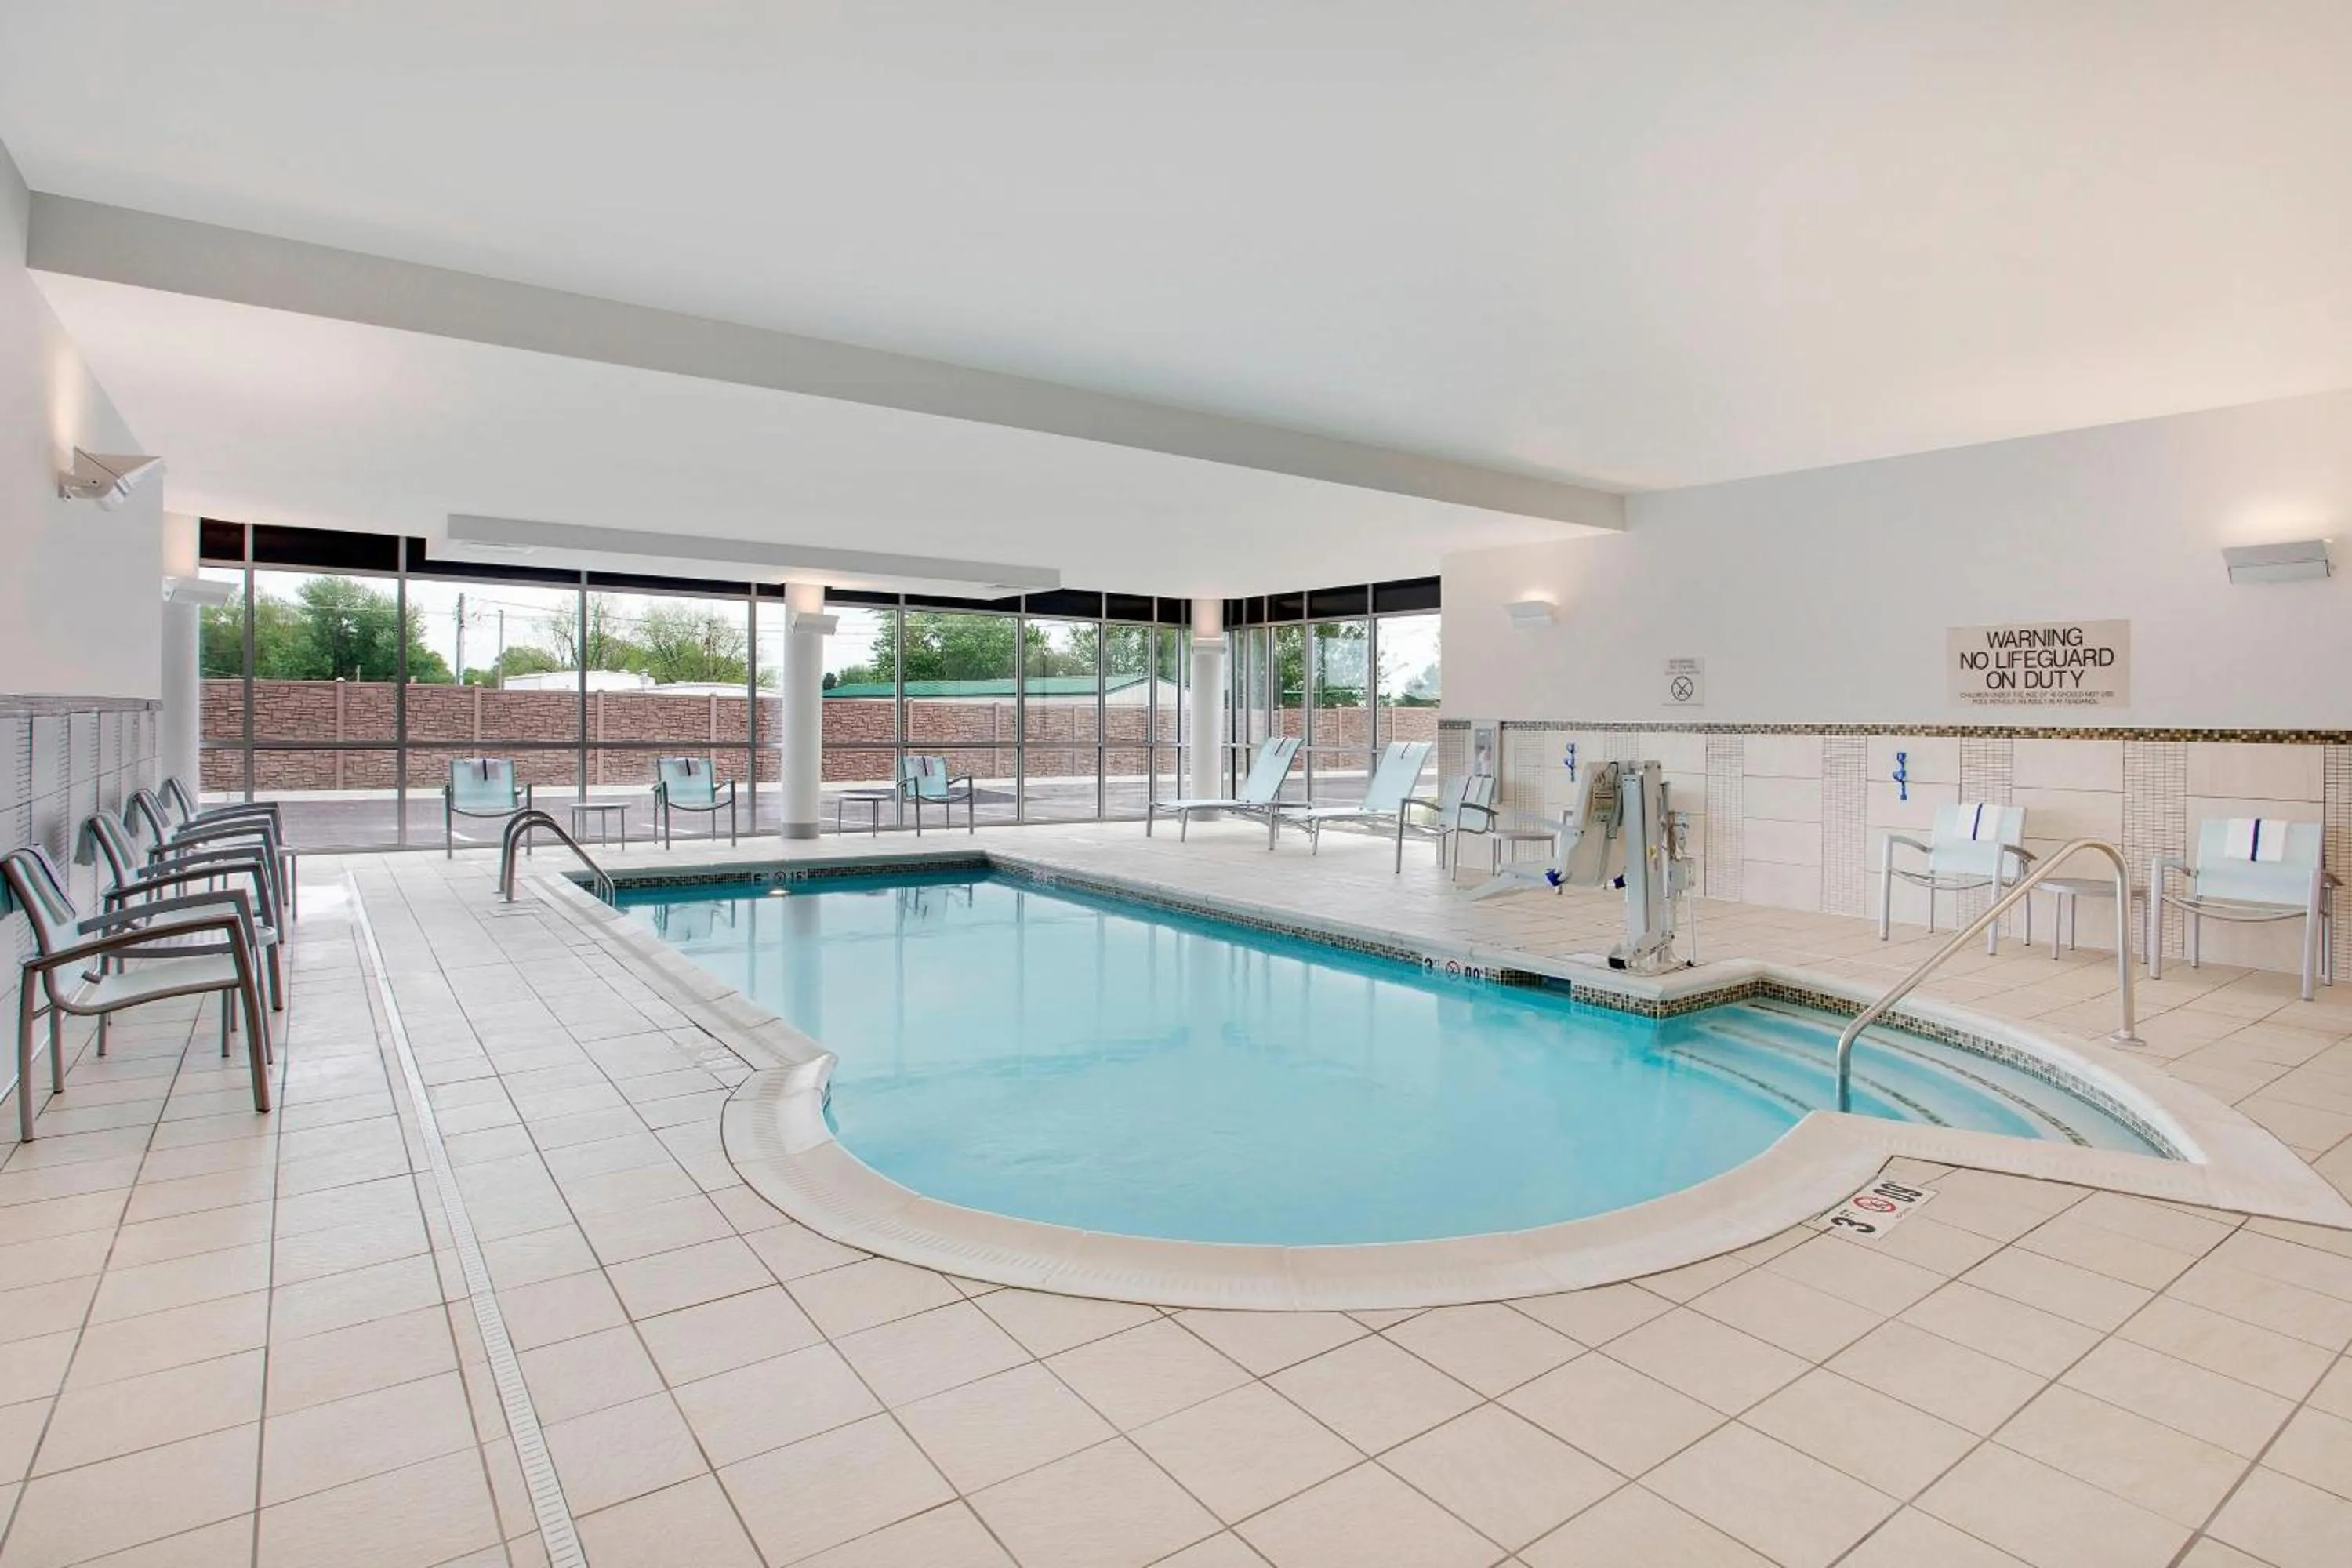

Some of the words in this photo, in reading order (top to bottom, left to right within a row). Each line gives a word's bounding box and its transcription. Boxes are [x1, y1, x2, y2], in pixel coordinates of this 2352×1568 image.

[1987, 627, 2083, 648] WARNING
[1960, 652, 1989, 670] NO
[1995, 648, 2114, 669] LIFEGUARD
[1986, 670, 2016, 689] ON
[2024, 670, 2084, 688] DUTY
[1831, 1216, 1876, 1233] 3
